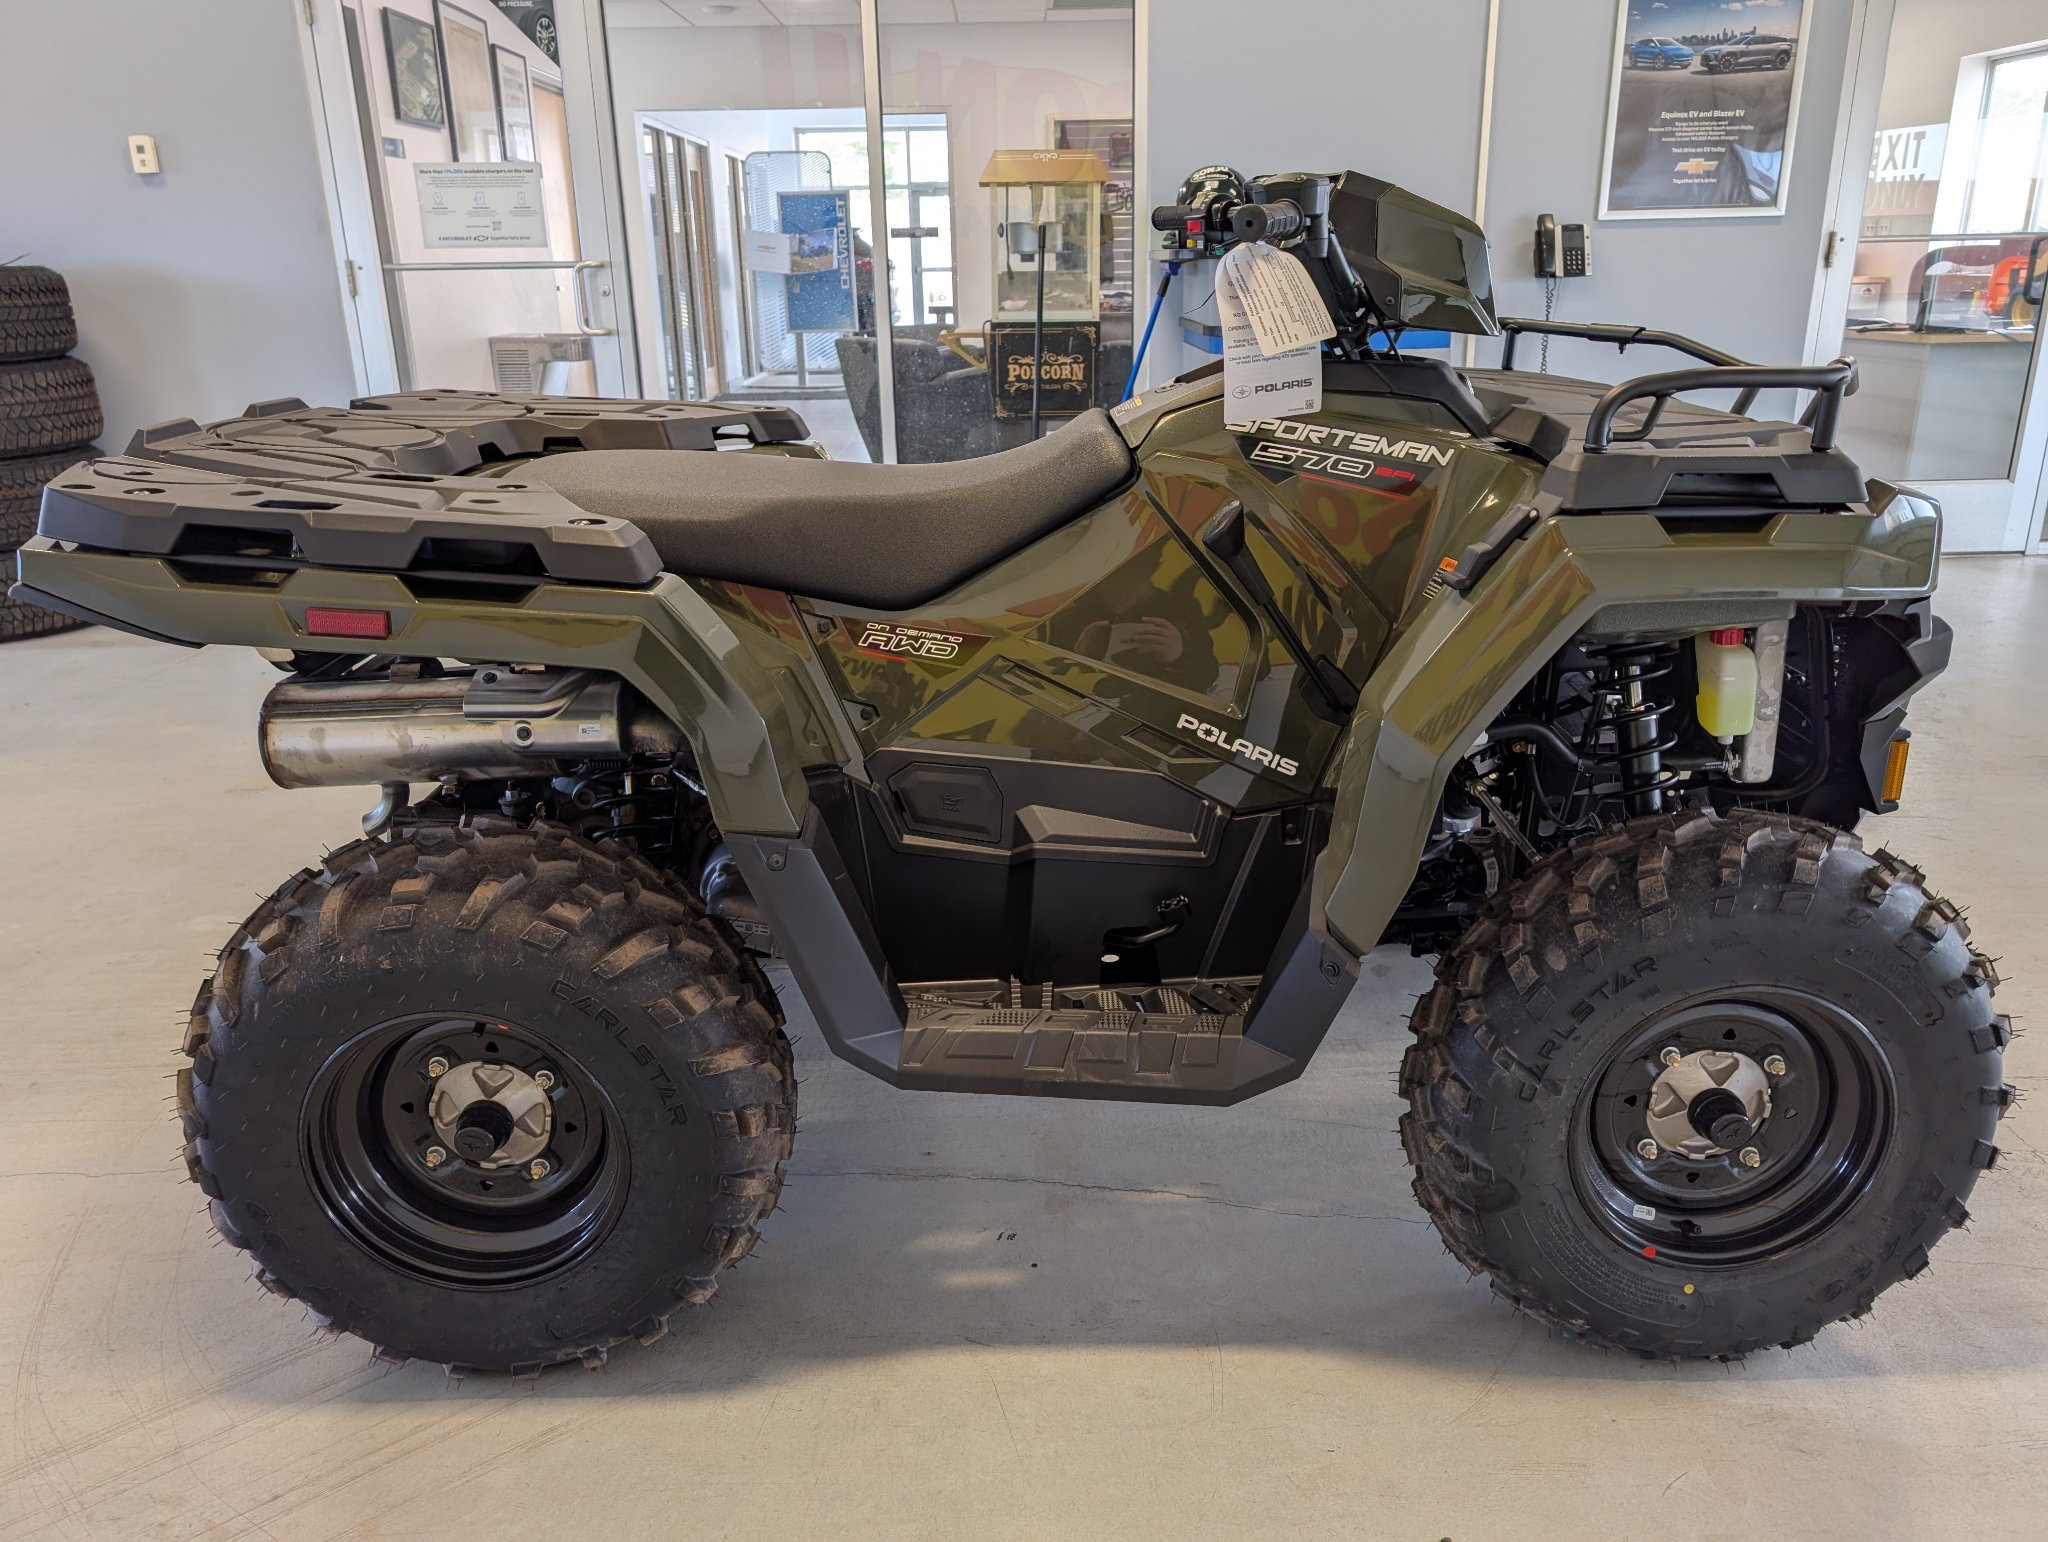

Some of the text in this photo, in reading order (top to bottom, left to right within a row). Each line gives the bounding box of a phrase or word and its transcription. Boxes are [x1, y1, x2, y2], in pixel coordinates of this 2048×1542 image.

[1661, 111, 1688, 119] Equinox
[1735, 109, 1745, 117] EV
[836, 197, 850, 289] CHEVROLET
[1255, 378, 1312, 394] POLARIS
[1225, 418, 1456, 467] SPORTSMAN
[1250, 441, 1416, 482] 570 EFI
[858, 630, 959, 660] AWD
[866, 622, 963, 643] ON DEMAND
[1176, 713, 1299, 777] POLARIS
[550, 976, 689, 1127] CARLSTAR
[1516, 955, 1660, 1103] CARLSTAR
